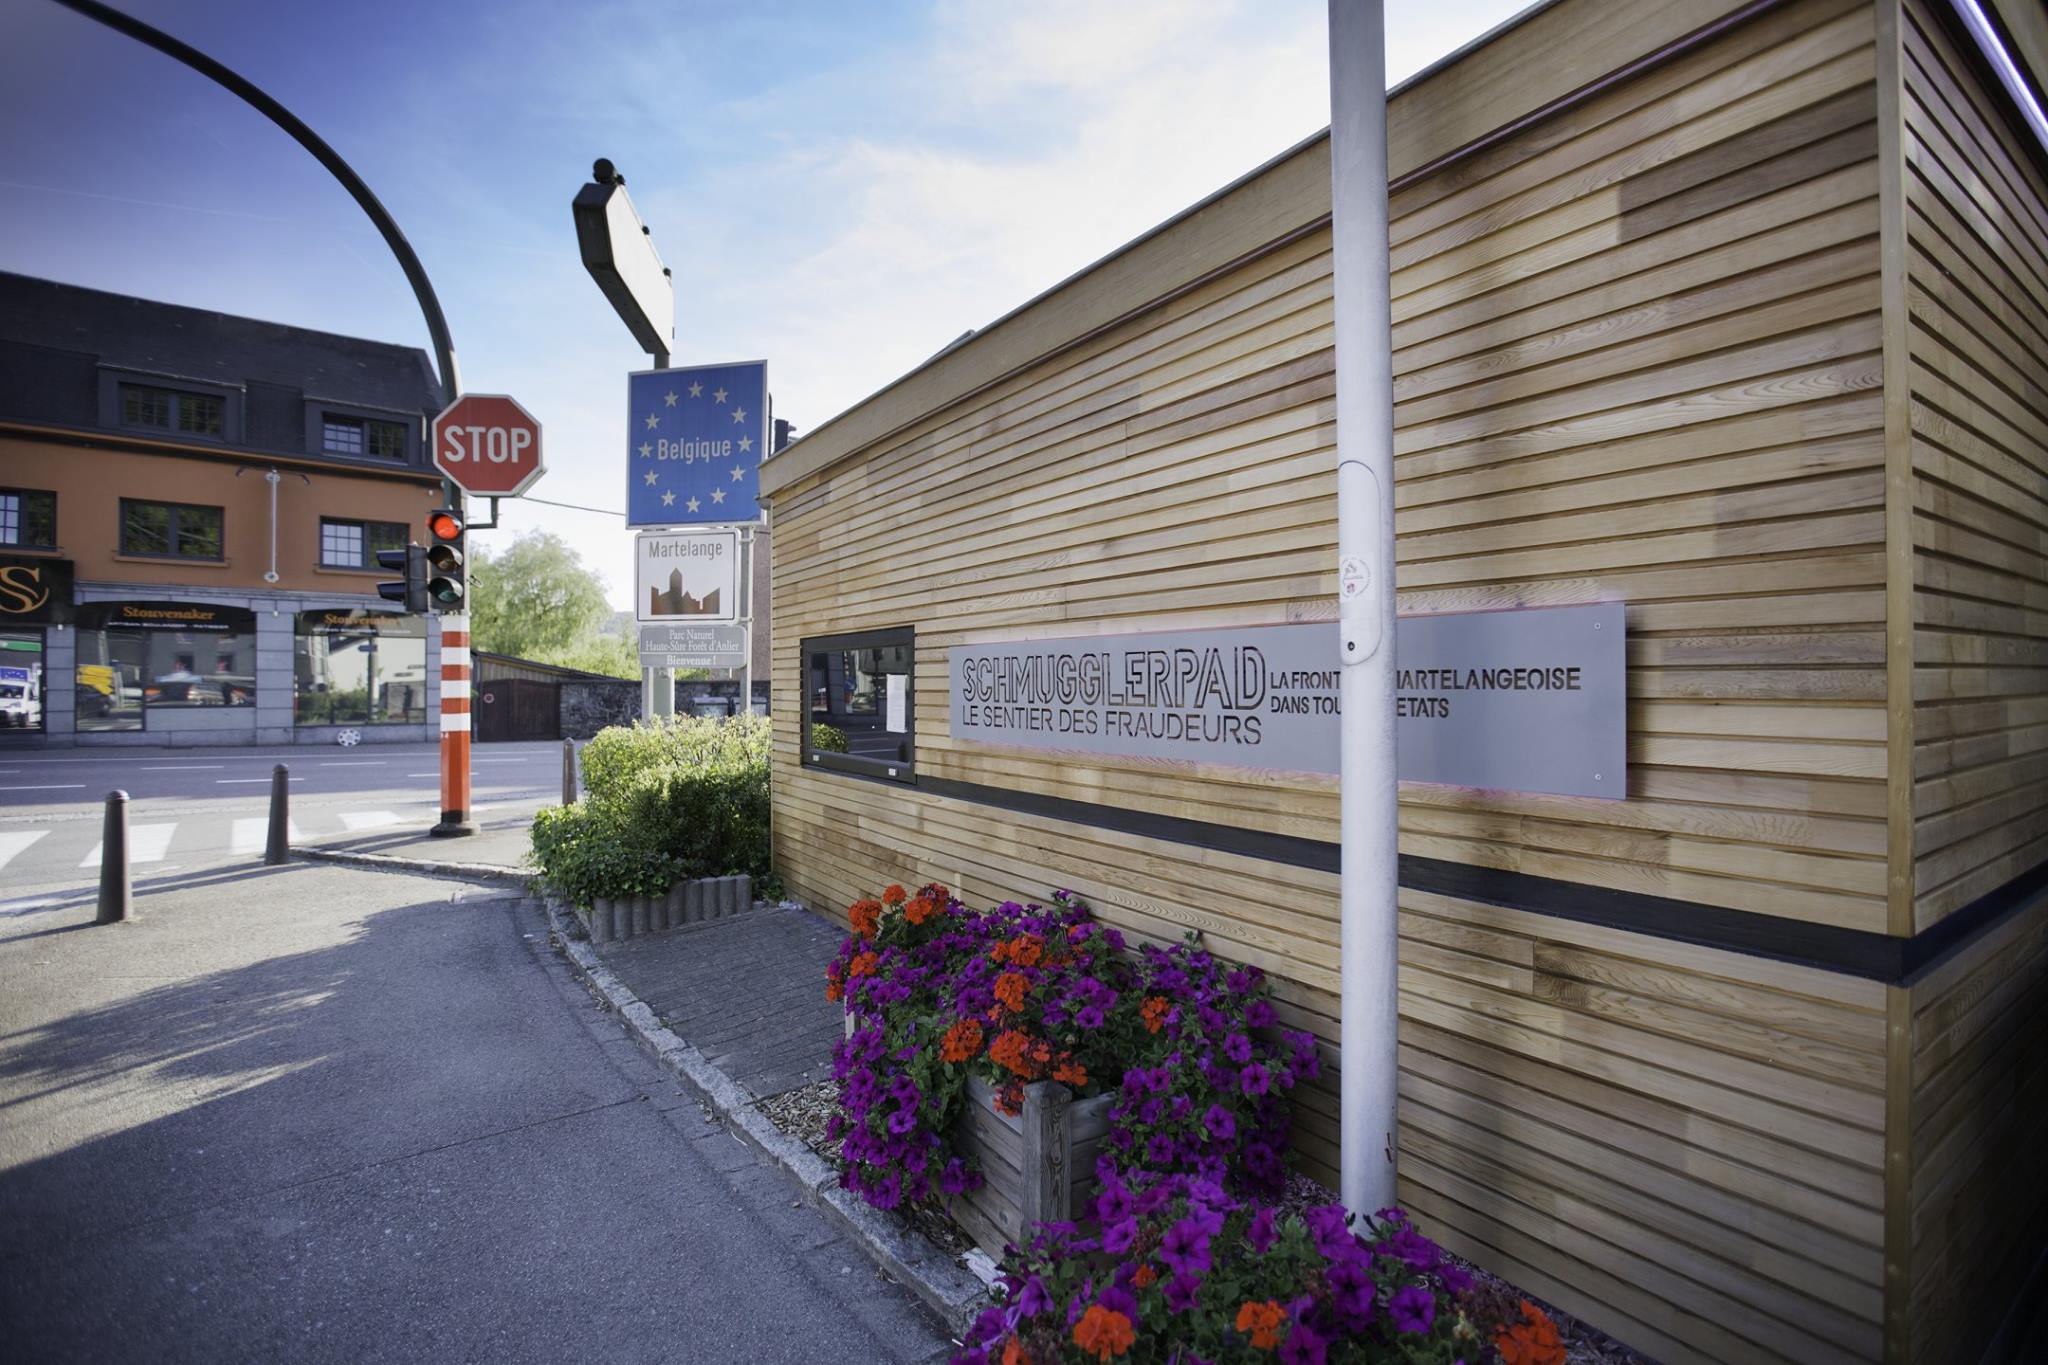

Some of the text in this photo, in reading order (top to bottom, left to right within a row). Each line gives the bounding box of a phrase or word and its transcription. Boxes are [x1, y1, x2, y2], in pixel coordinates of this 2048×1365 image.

[444, 425, 532, 463] STOP
[658, 437, 731, 464] Belgique
[649, 541, 722, 560] Martelange
[669, 628, 714, 640] Parc Naturel
[688, 640, 706, 651] Forêt
[666, 654, 711, 665] Bienvenue
[962, 646, 1266, 710] SCHMUGGLERPAD
[1270, 671, 1289, 689] LA
[1291, 671, 1341, 689] FRONT
[1271, 695, 1449, 718] DANS TOU ETATS
[962, 705, 1262, 745] LE SENTIER DES FRAUDEURS
